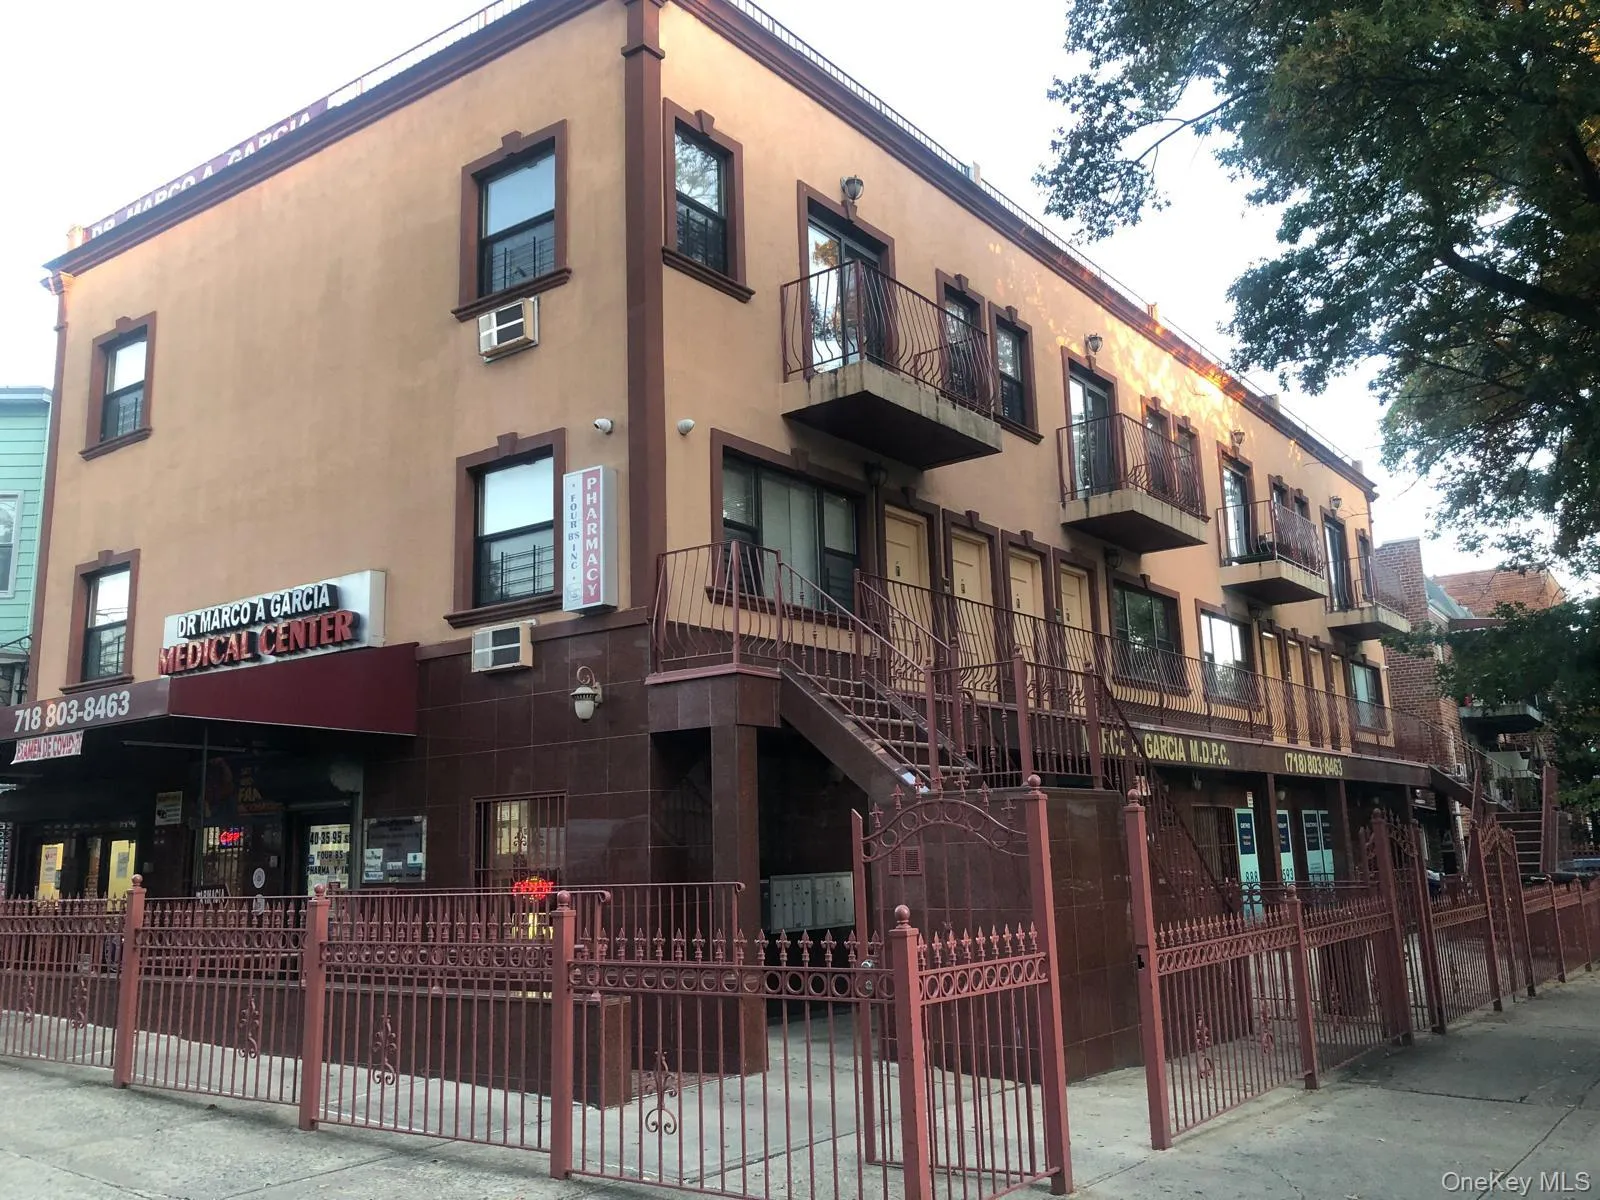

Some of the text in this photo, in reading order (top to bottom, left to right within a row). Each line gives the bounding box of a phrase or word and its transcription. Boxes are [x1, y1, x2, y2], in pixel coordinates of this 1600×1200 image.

[586, 476, 598, 597] PHARMACY
[177, 584, 330, 637] DR MARCO A GARCIA
[158, 611, 354, 675] MEDICAL CENTER
[14, 691, 130, 732] 718 803-8463
[43, 737, 52, 758] DE
[1144, 733, 1186, 762] GARCIA
[1189, 739, 1230, 766] M.D.P.C.
